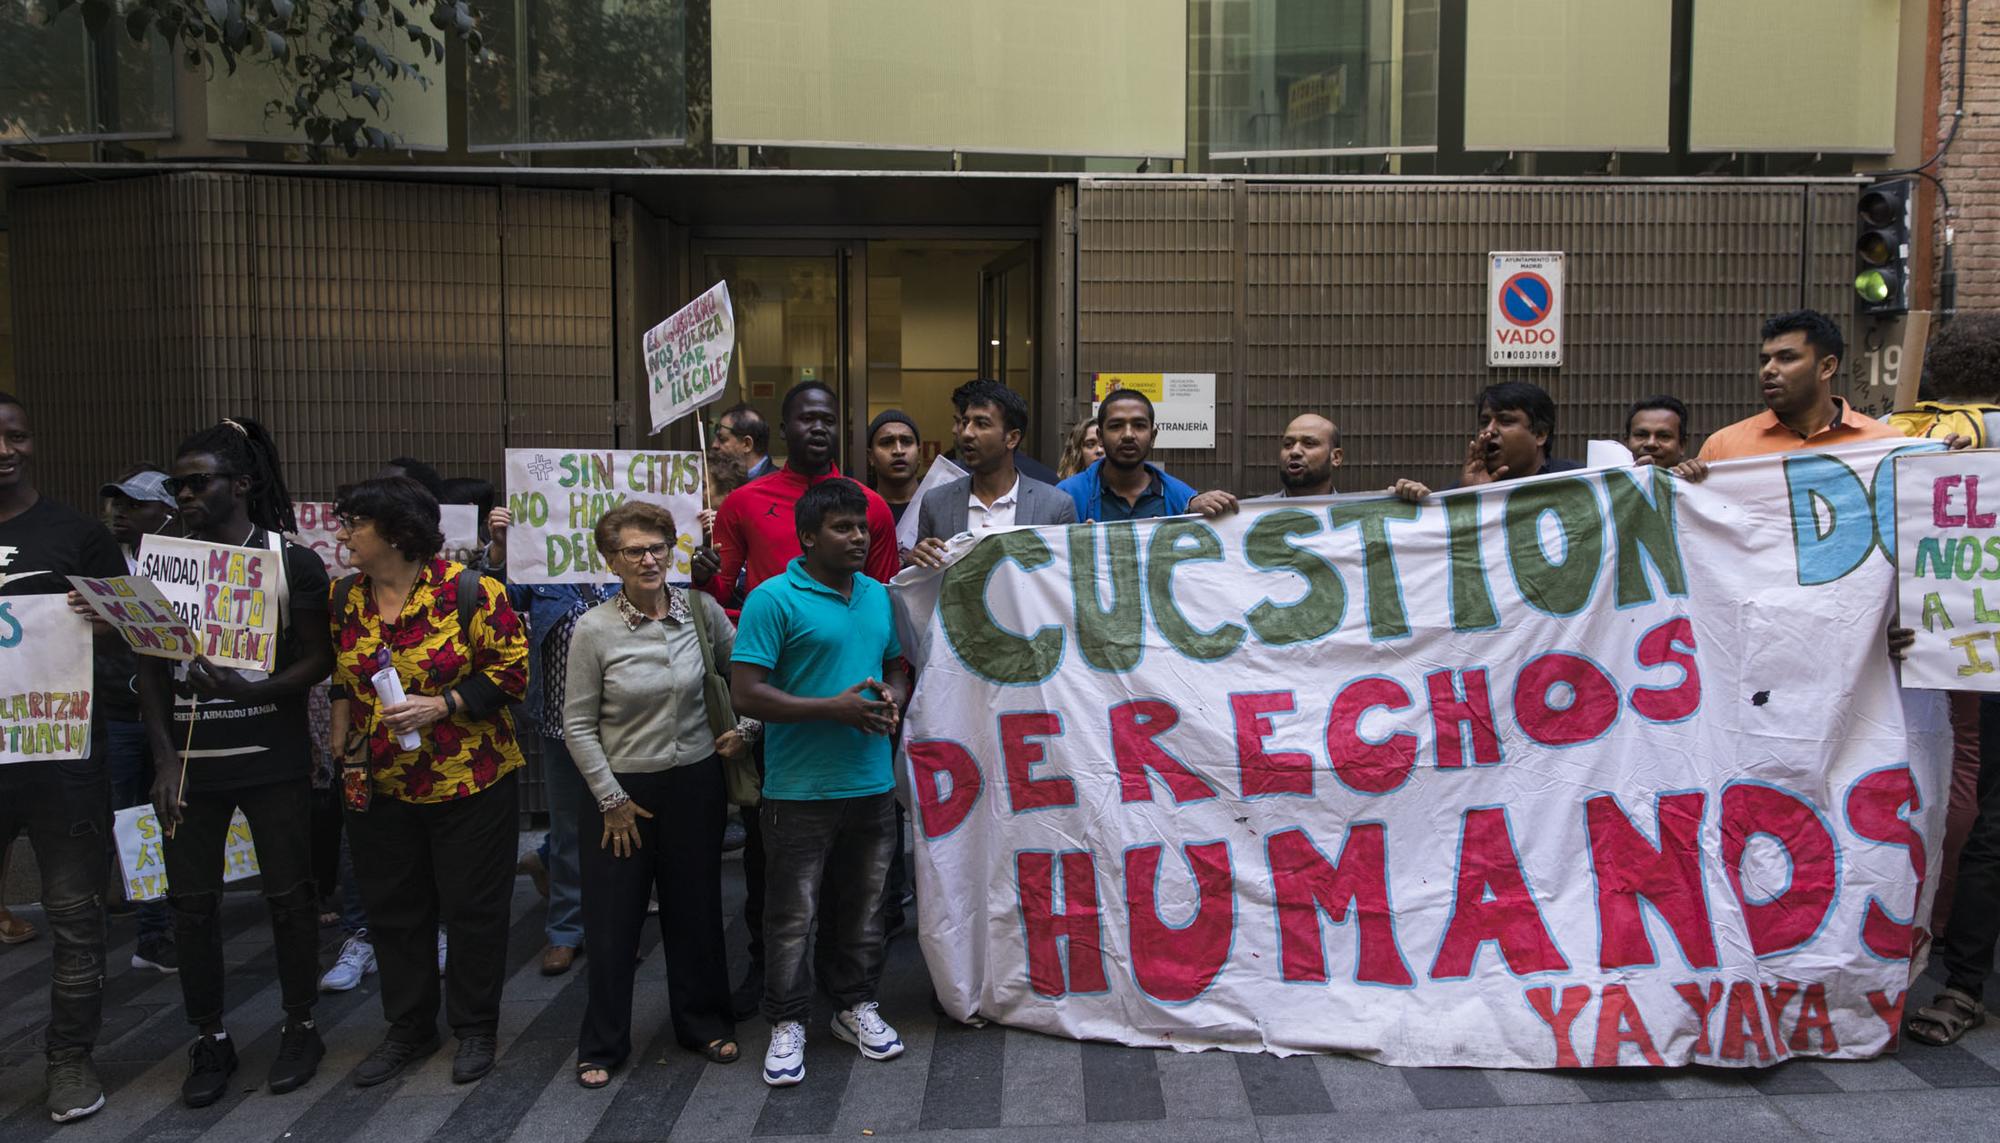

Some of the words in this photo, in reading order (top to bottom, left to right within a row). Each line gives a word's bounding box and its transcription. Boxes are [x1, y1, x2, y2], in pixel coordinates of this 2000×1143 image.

[648, 330, 661, 352] EL
[663, 290, 716, 341] GOBIERNO
[1496, 328, 1555, 344] VADO
[648, 344, 673, 375] NOS
[655, 375, 663, 394] A
[667, 345, 706, 382] ESTAR
[1864, 344, 1903, 386] 19
[558, 453, 614, 490] SIN
[628, 453, 700, 496] CITAS
[509, 491, 548, 528] NO
[1933, 475, 1997, 528] EL
[208, 549, 262, 588] MAS
[1914, 536, 2000, 581] NOS
[82, 578, 136, 597] NO
[1922, 592, 1954, 632] A
[907, 616, 1702, 840] DERECHOS
[1015, 762, 1926, 1006] HUMANOS
[1523, 983, 1664, 1068] YA
